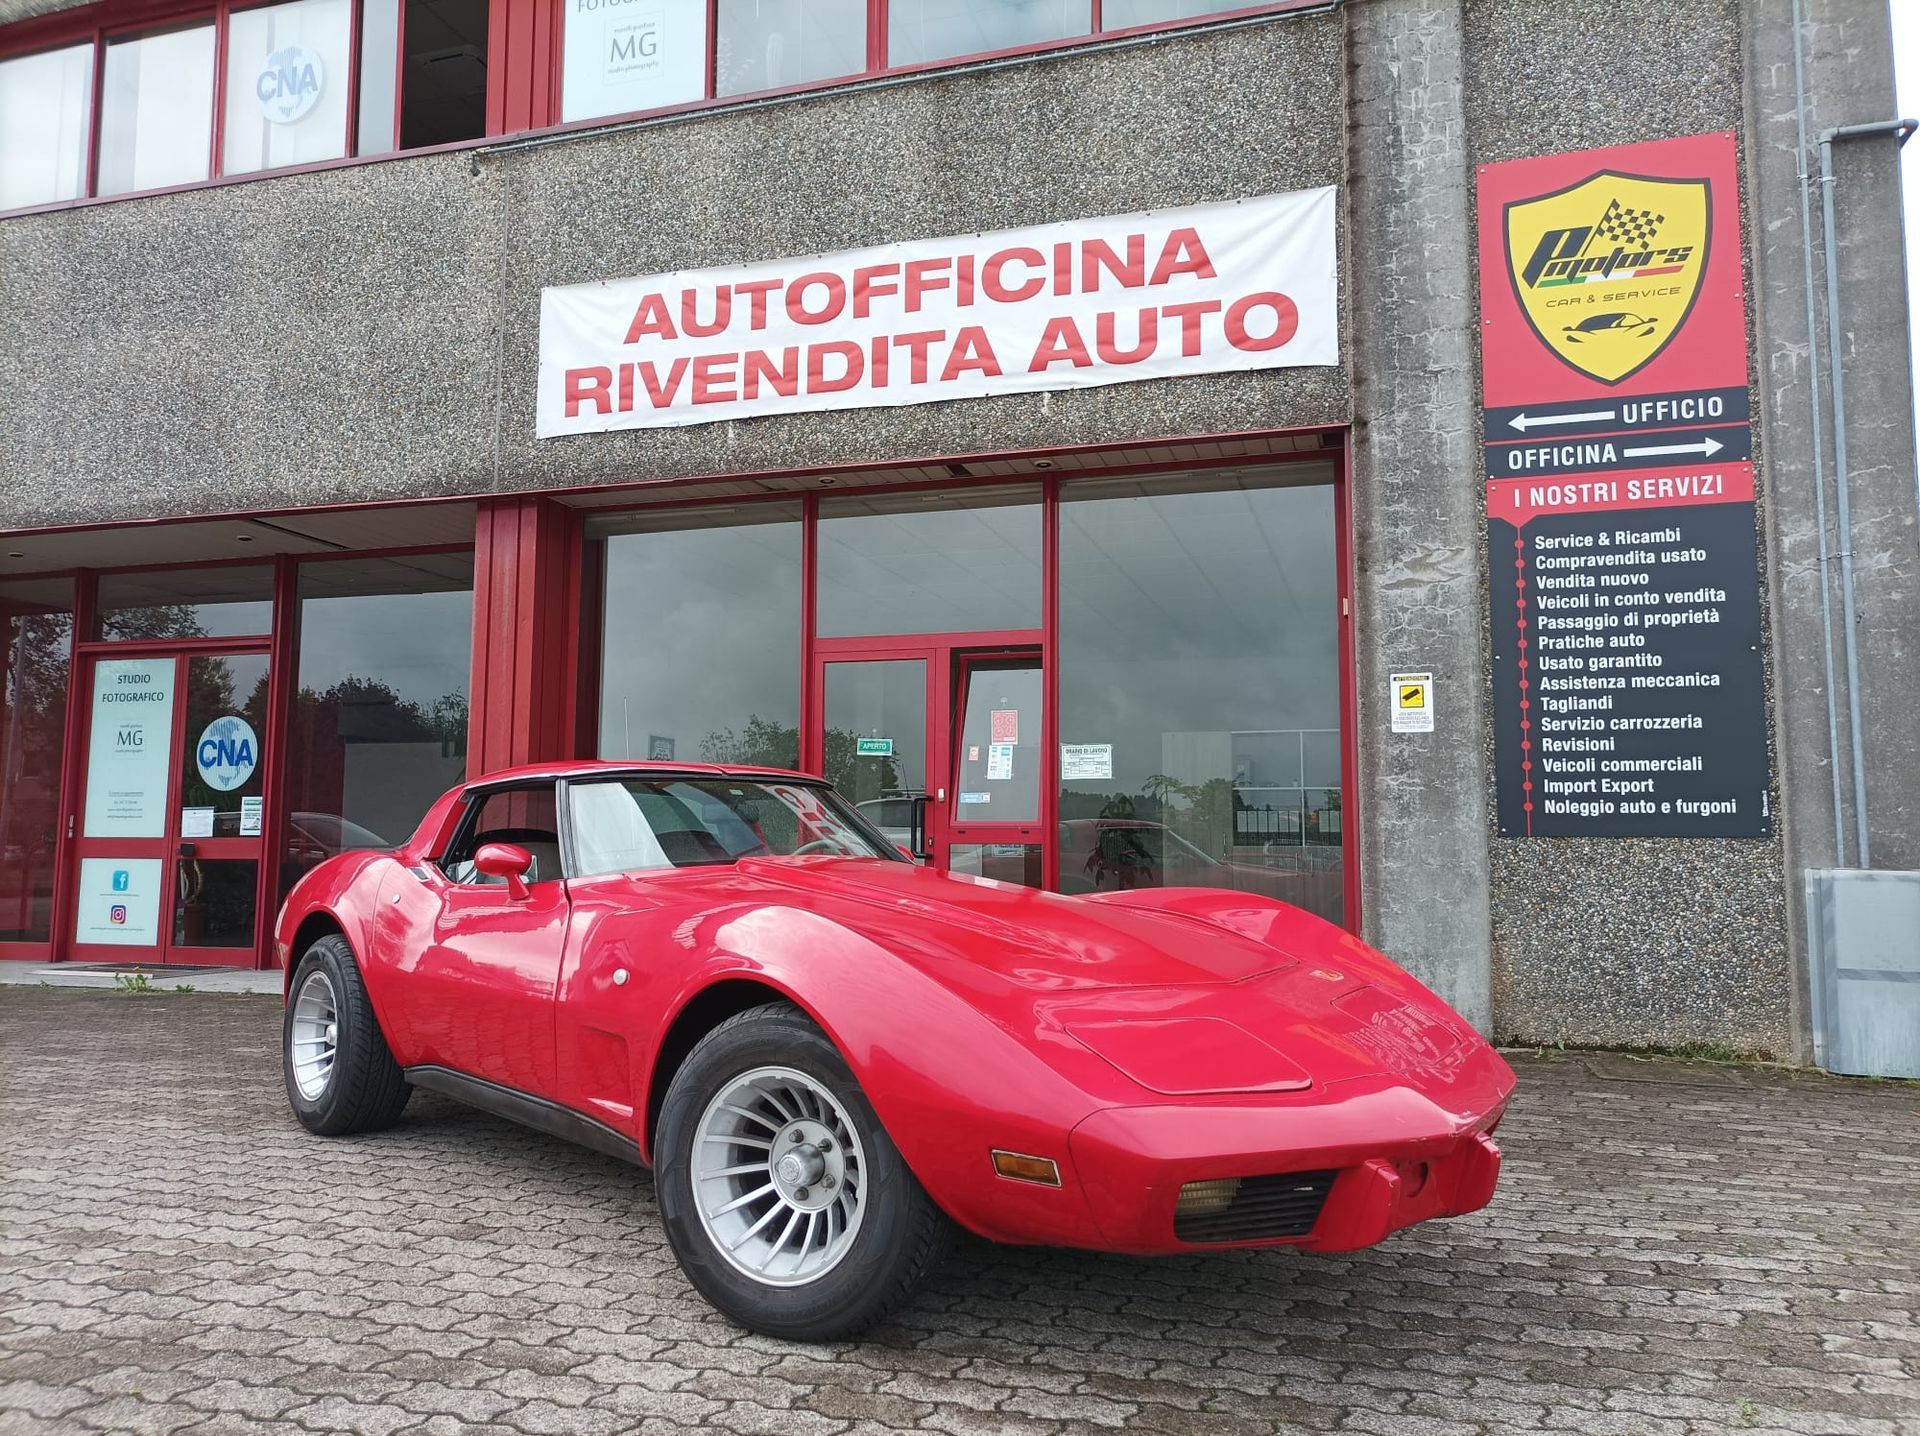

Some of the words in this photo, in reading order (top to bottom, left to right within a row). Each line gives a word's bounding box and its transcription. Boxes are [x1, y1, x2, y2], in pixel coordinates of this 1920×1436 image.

[609, 31, 657, 62] MG
[256, 63, 319, 102] CNA
[624, 228, 1216, 343] AUTOFFICINA
[1546, 297, 1581, 308] CAR
[1586, 294, 1596, 304] &
[1603, 286, 1682, 302] SERVICE
[564, 326, 1001, 418] RIVENDITA
[1028, 292, 1299, 372] AUTO
[1622, 396, 1723, 424] UFFICIO
[1508, 443, 1617, 470] OFFICINA
[1514, 488, 1521, 508] I
[1530, 481, 1618, 507] NOSTRI
[1627, 474, 1723, 500] SERVIZI
[1535, 533, 1594, 549] Service
[1598, 531, 1611, 545] &
[1616, 527, 1681, 544] Ricambi
[1536, 550, 1656, 570] Compravendita
[1661, 547, 1707, 563] usato
[1536, 573, 1596, 589] Vendita
[1601, 573, 1650, 586] nuovo
[1537, 593, 1590, 609] Veicoli
[1595, 592, 1610, 607] in
[1615, 591, 1660, 606] conto
[1665, 587, 1726, 603] vendita
[1538, 612, 1619, 630] Passaggio
[1624, 611, 1639, 626] di
[1644, 607, 1720, 628] proprietà
[1539, 634, 1605, 649] Pratiche
[1610, 632, 1646, 647] auto
[1540, 655, 1584, 670] Usato
[1589, 652, 1663, 671] garantito
[117, 673, 151, 684] STUDIO
[1540, 675, 1626, 690] Assistenza
[1632, 671, 1721, 687] meccanica
[102, 691, 164, 702] FOTOGRAFICO
[1540, 694, 1613, 713] Tagliandi
[1542, 716, 1605, 731] Servizio
[1610, 713, 1703, 730] carrozzeria
[116, 730, 143, 746] MG
[862, 742, 887, 750] APERTO
[1543, 736, 1615, 751] Revisioni
[199, 738, 254, 768] CNA
[1543, 757, 1596, 772] Veicoli
[1601, 755, 1703, 771] commerciali
[1544, 778, 1597, 795] Import
[1602, 778, 1655, 795] Export
[1545, 799, 1615, 816] Noleggio
[1620, 799, 1656, 813] auto
[1661, 801, 1671, 813] e
[1676, 798, 1737, 816] furgoni
